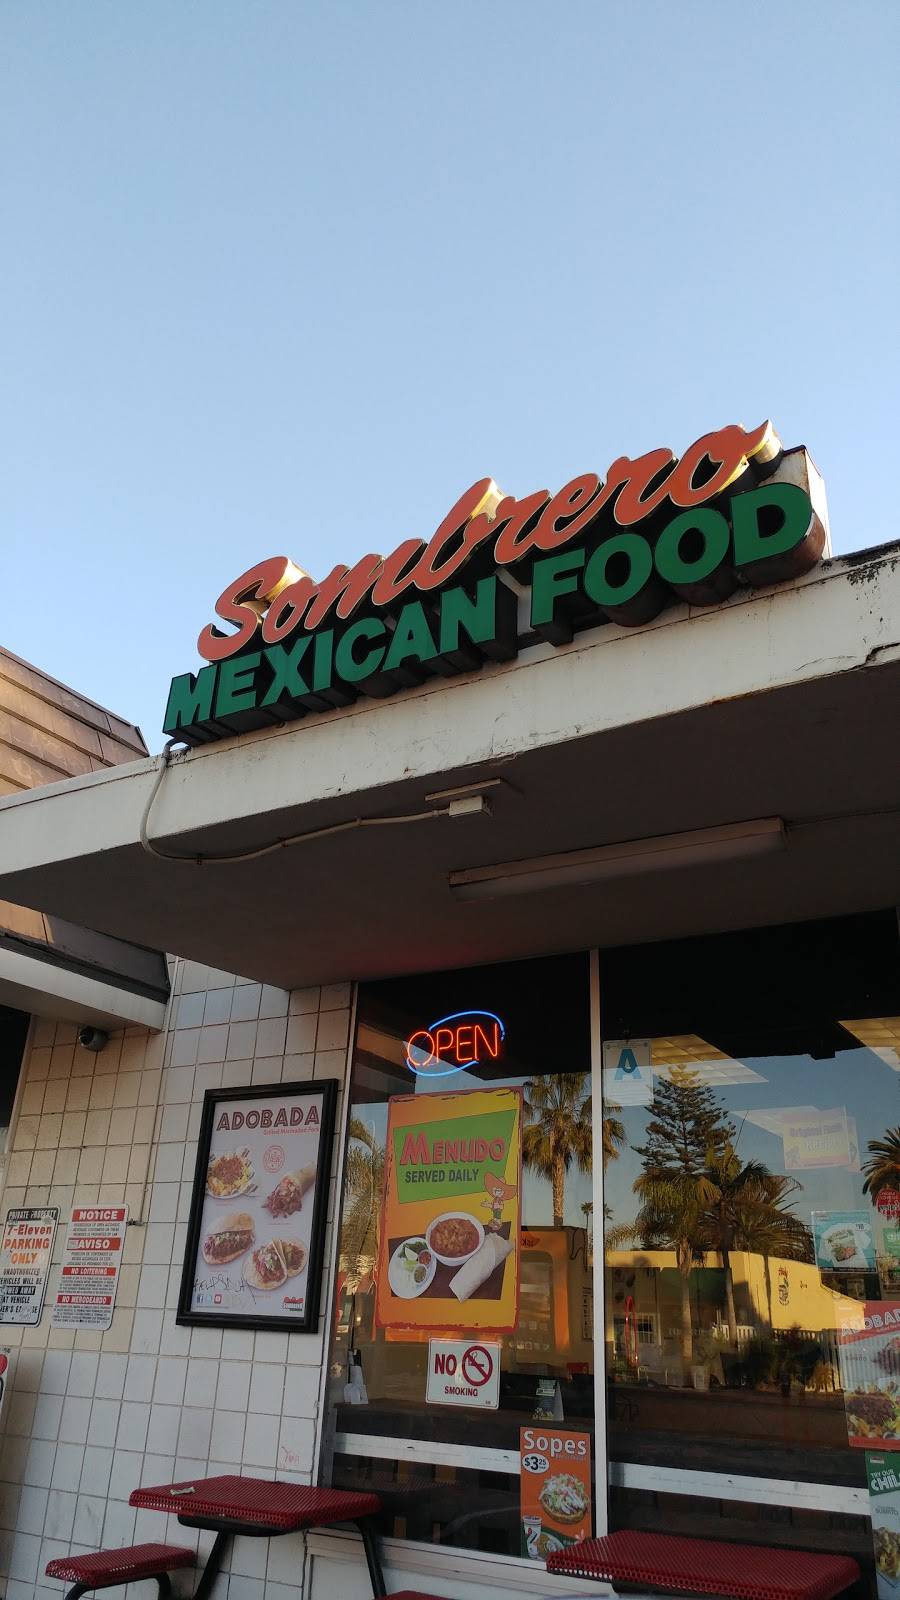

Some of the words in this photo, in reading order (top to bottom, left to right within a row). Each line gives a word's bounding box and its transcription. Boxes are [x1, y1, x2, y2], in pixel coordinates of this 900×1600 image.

[197, 420, 774, 661] Sombrero
[163, 577, 498, 734] MEXICAN
[530, 482, 813, 628] FOOD
[407, 1023, 499, 1067] OPEN
[614, 1048, 643, 1080] A
[216, 1105, 320, 1131] ADOBADA
[405, 1169, 445, 1183] SERVED
[448, 1168, 480, 1182] DAILY
[79, 1210, 118, 1220] NOTICE
[7, 1224, 52, 1236] 7-Eleven
[4, 1238, 49, 1249] PARKING
[78, 1239, 110, 1249] AVISO
[10, 1252, 38, 1265] ONLY
[22, 1277, 34, 1285] WILL
[10, 1296, 30, 1304] VEHICLE
[434, 1353, 458, 1376] NO
[444, 1385, 479, 1397] SMOKING
[523, 1430, 587, 1457] Sopes
[881, 1469, 894, 1477] OUR
